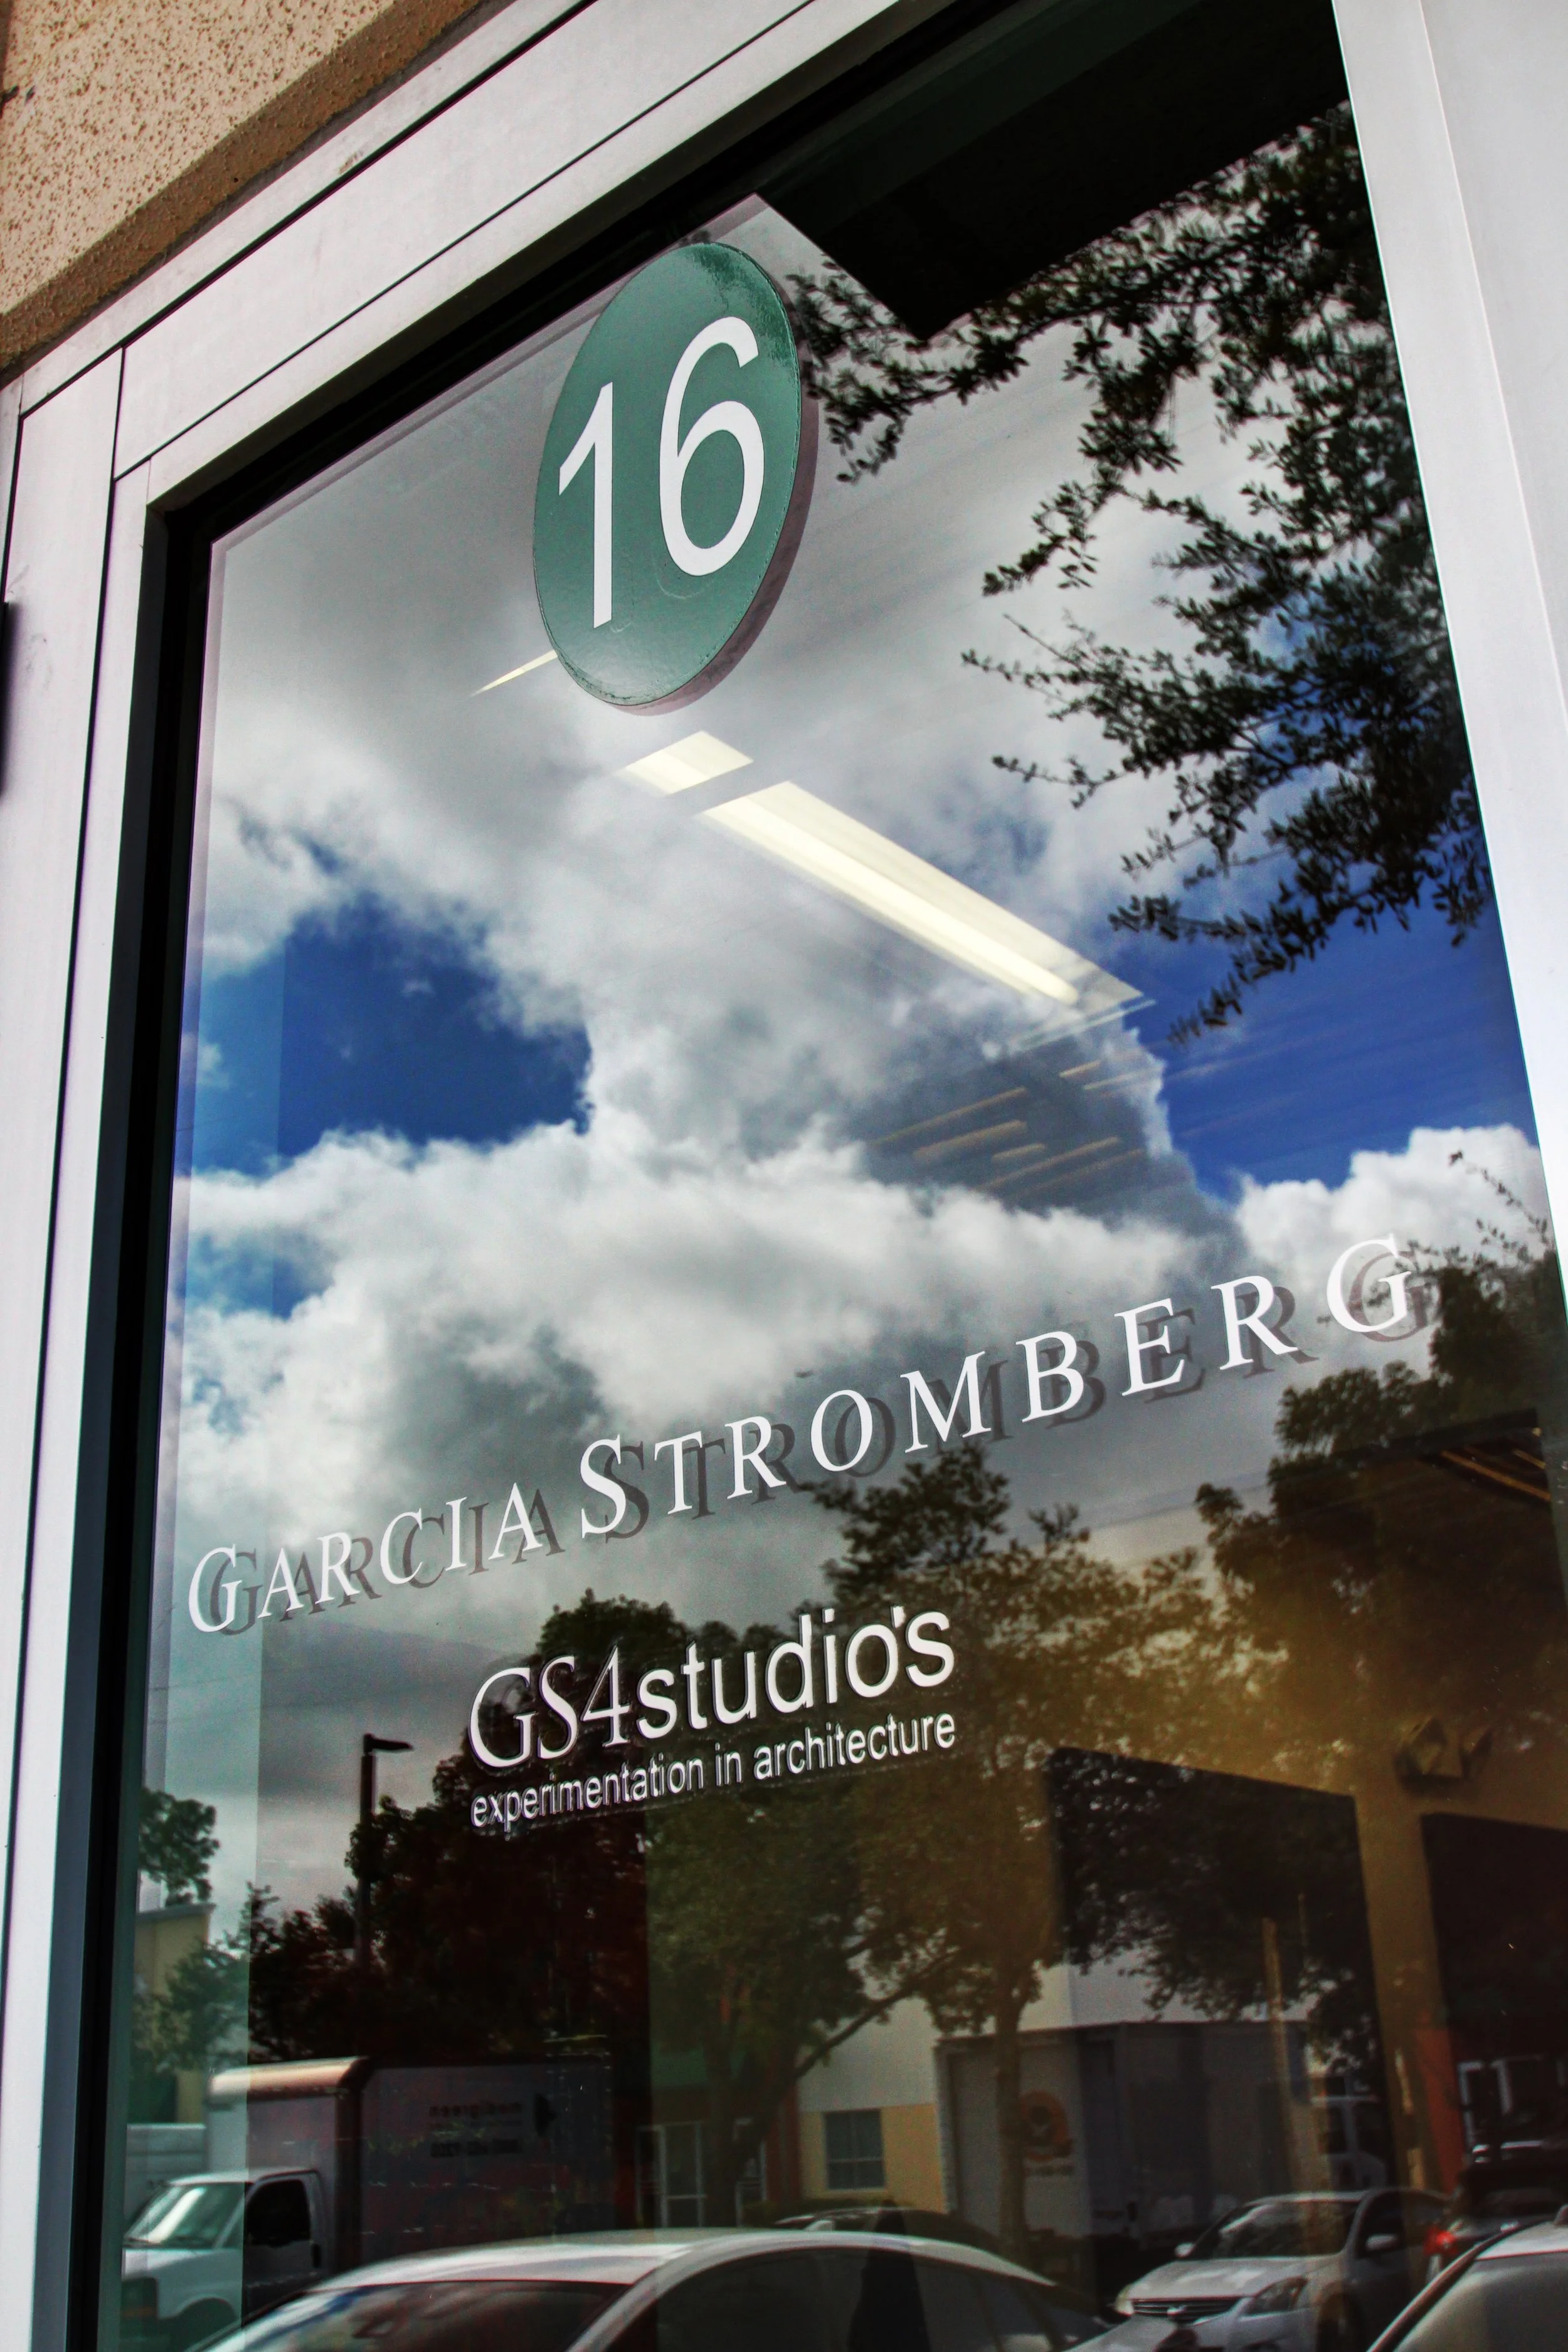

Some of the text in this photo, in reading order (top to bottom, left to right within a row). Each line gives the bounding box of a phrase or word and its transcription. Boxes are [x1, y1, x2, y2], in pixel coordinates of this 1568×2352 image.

[559, 317, 765, 628] 16
[188, 1234, 1412, 1633] GARCIA STROMBERG
[471, 1712, 956, 1830] experimentation in architecture
